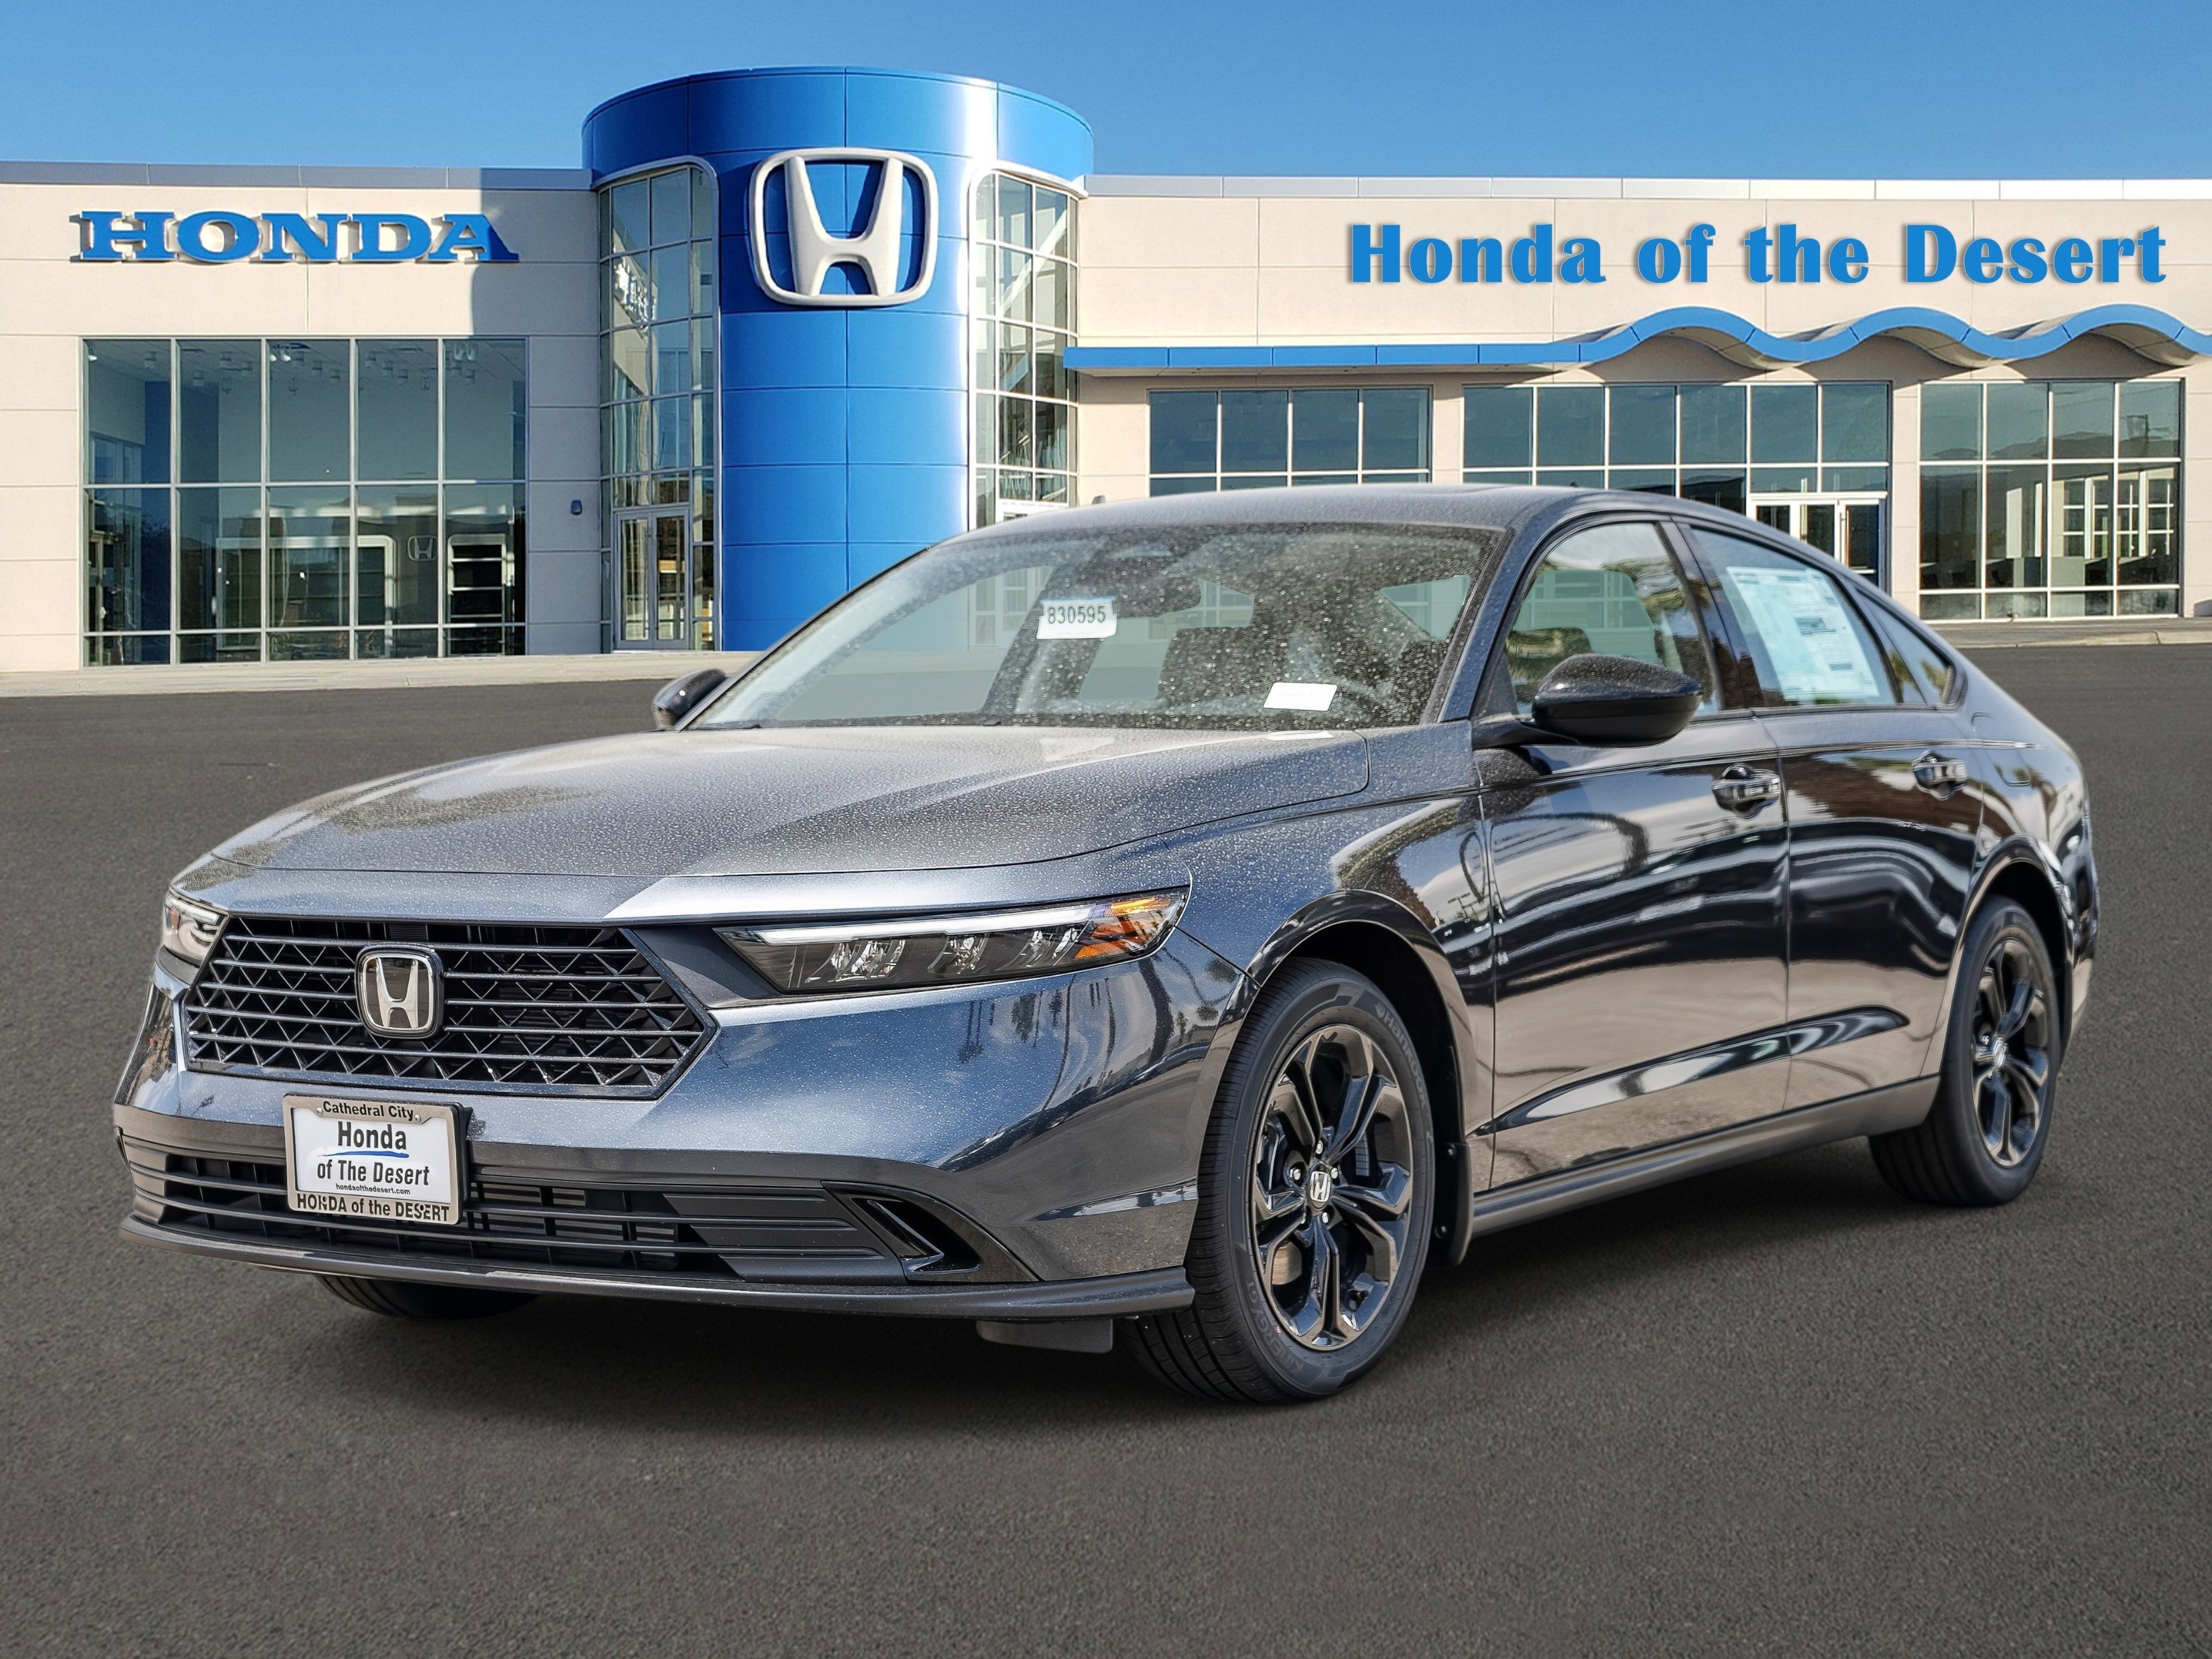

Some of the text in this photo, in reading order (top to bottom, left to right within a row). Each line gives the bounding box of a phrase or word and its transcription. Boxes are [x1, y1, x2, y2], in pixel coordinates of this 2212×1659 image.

[80, 210, 519, 262] HONDA
[1351, 223, 2167, 284] Honda of the Desert
[1048, 605, 1105, 624] 830595
[322, 1101, 414, 1121] Cathedral City
[338, 1121, 406, 1150] Honda
[317, 1159, 430, 1185] of The Desert
[336, 1183, 410, 1195] hondaofthedesert.com
[297, 1193, 449, 1222] HONDA of the DESERT
